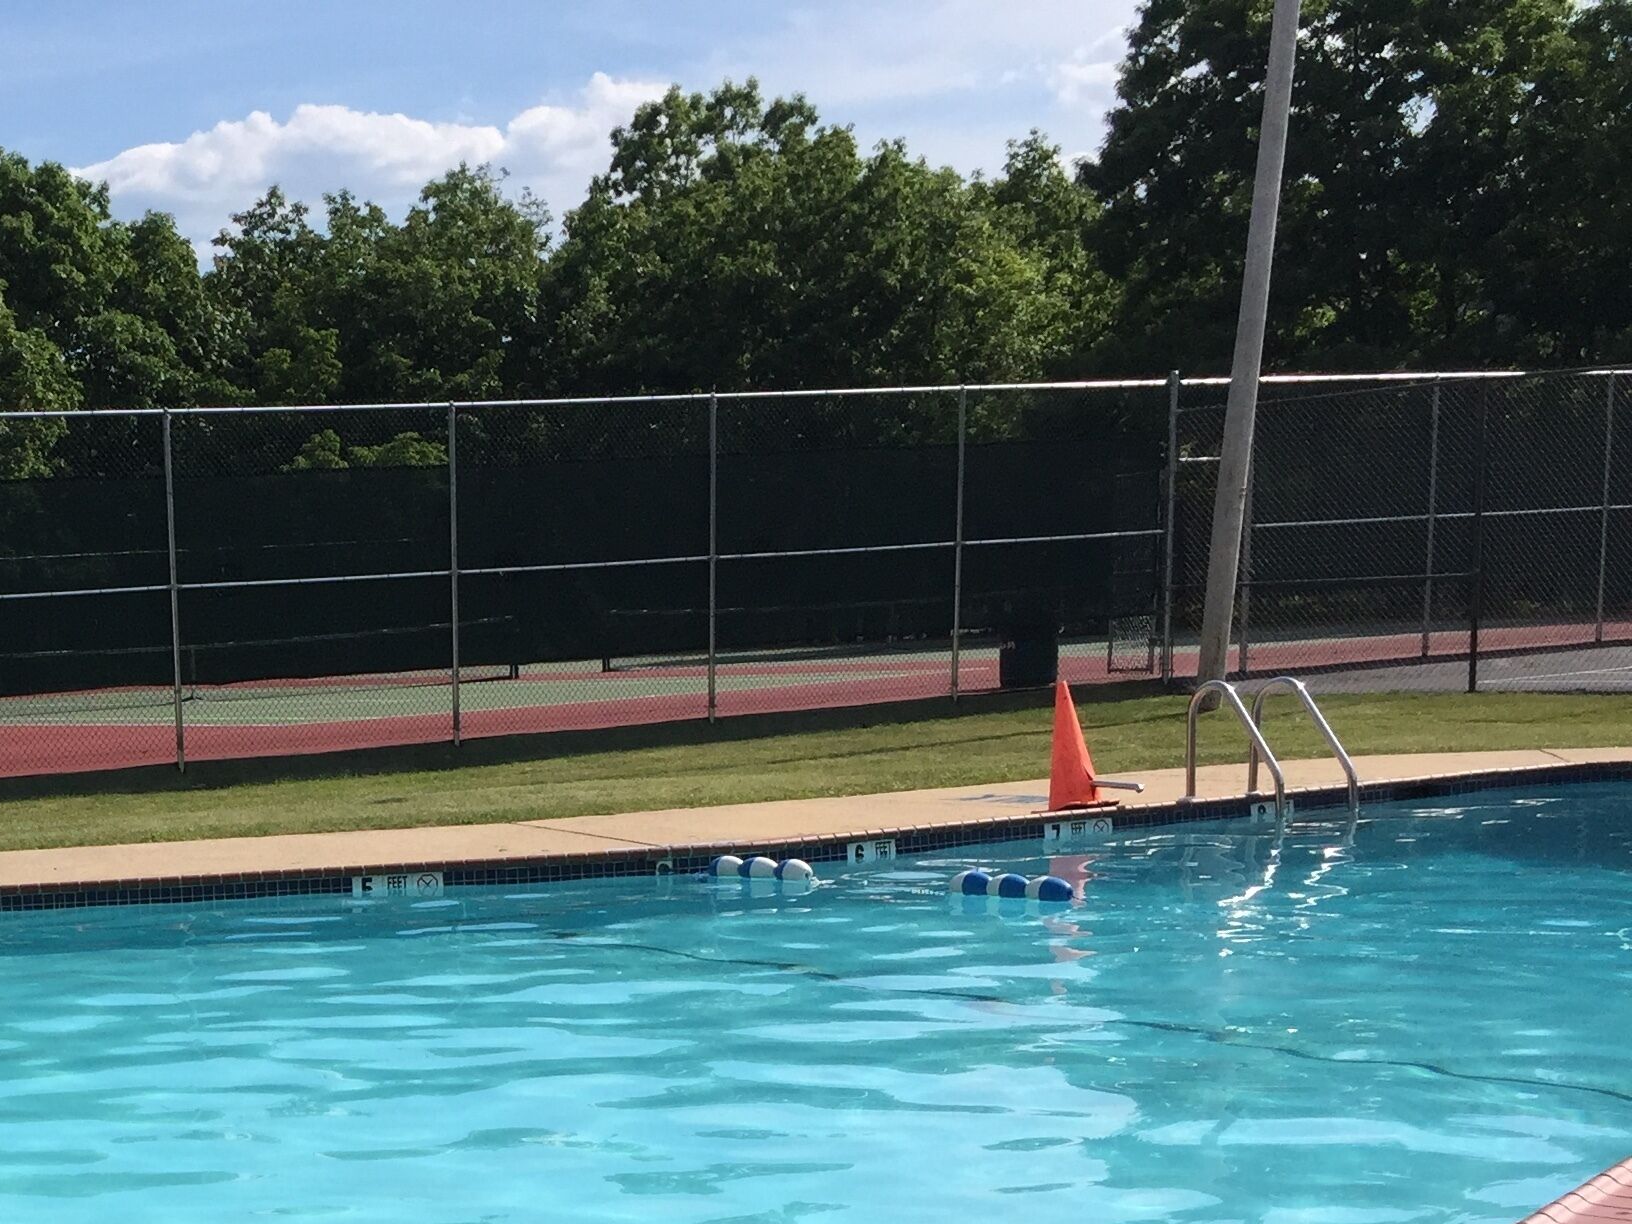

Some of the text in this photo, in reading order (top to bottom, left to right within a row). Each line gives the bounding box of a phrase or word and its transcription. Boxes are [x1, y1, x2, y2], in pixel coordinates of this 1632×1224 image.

[1051, 823, 1060, 839] 7
[854, 844, 864, 859] 6
[361, 875, 407, 891] 5 FEET
